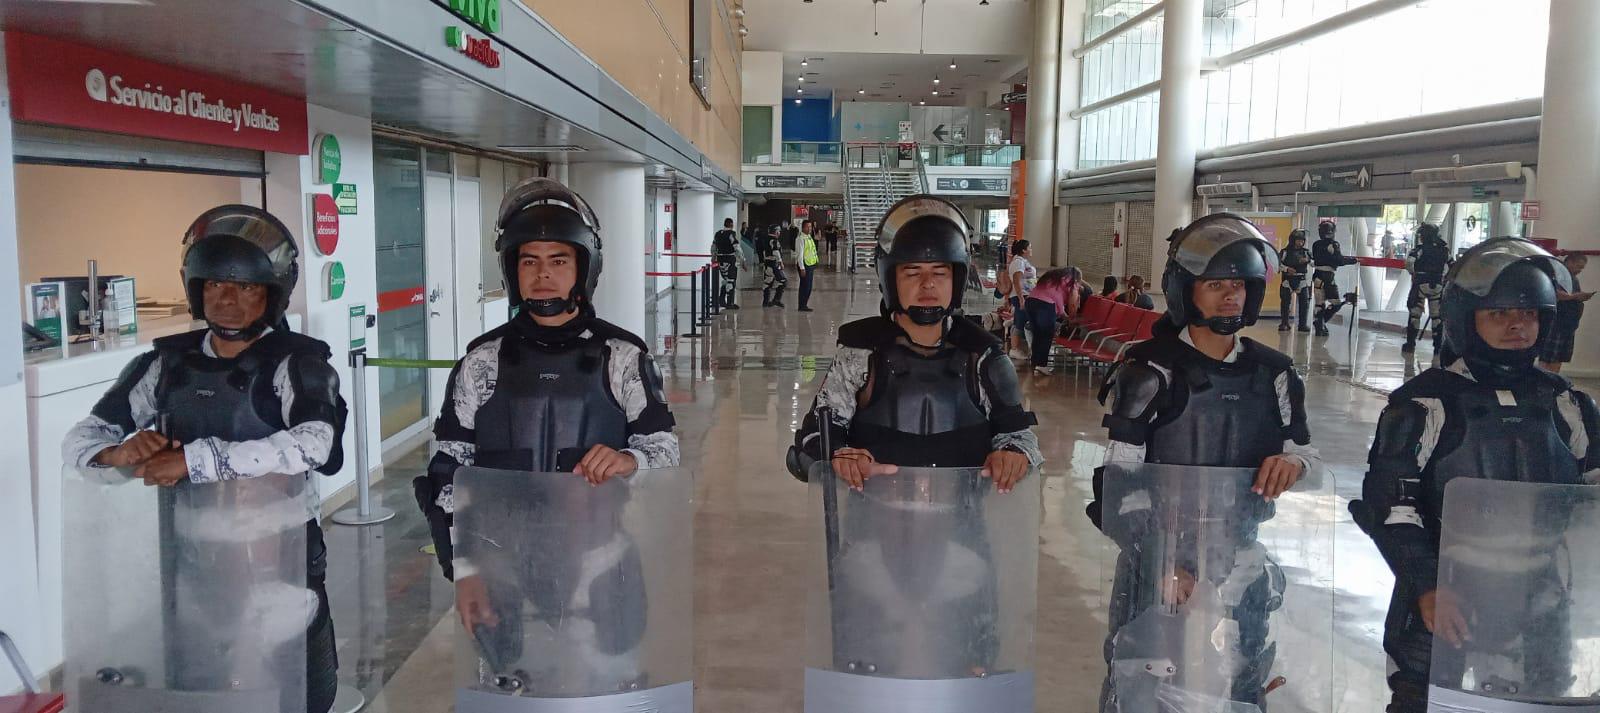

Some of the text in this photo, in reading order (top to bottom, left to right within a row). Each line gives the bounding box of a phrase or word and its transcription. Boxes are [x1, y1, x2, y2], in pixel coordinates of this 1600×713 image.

[110, 75, 280, 132] Servicio al Cliente y Ventas
